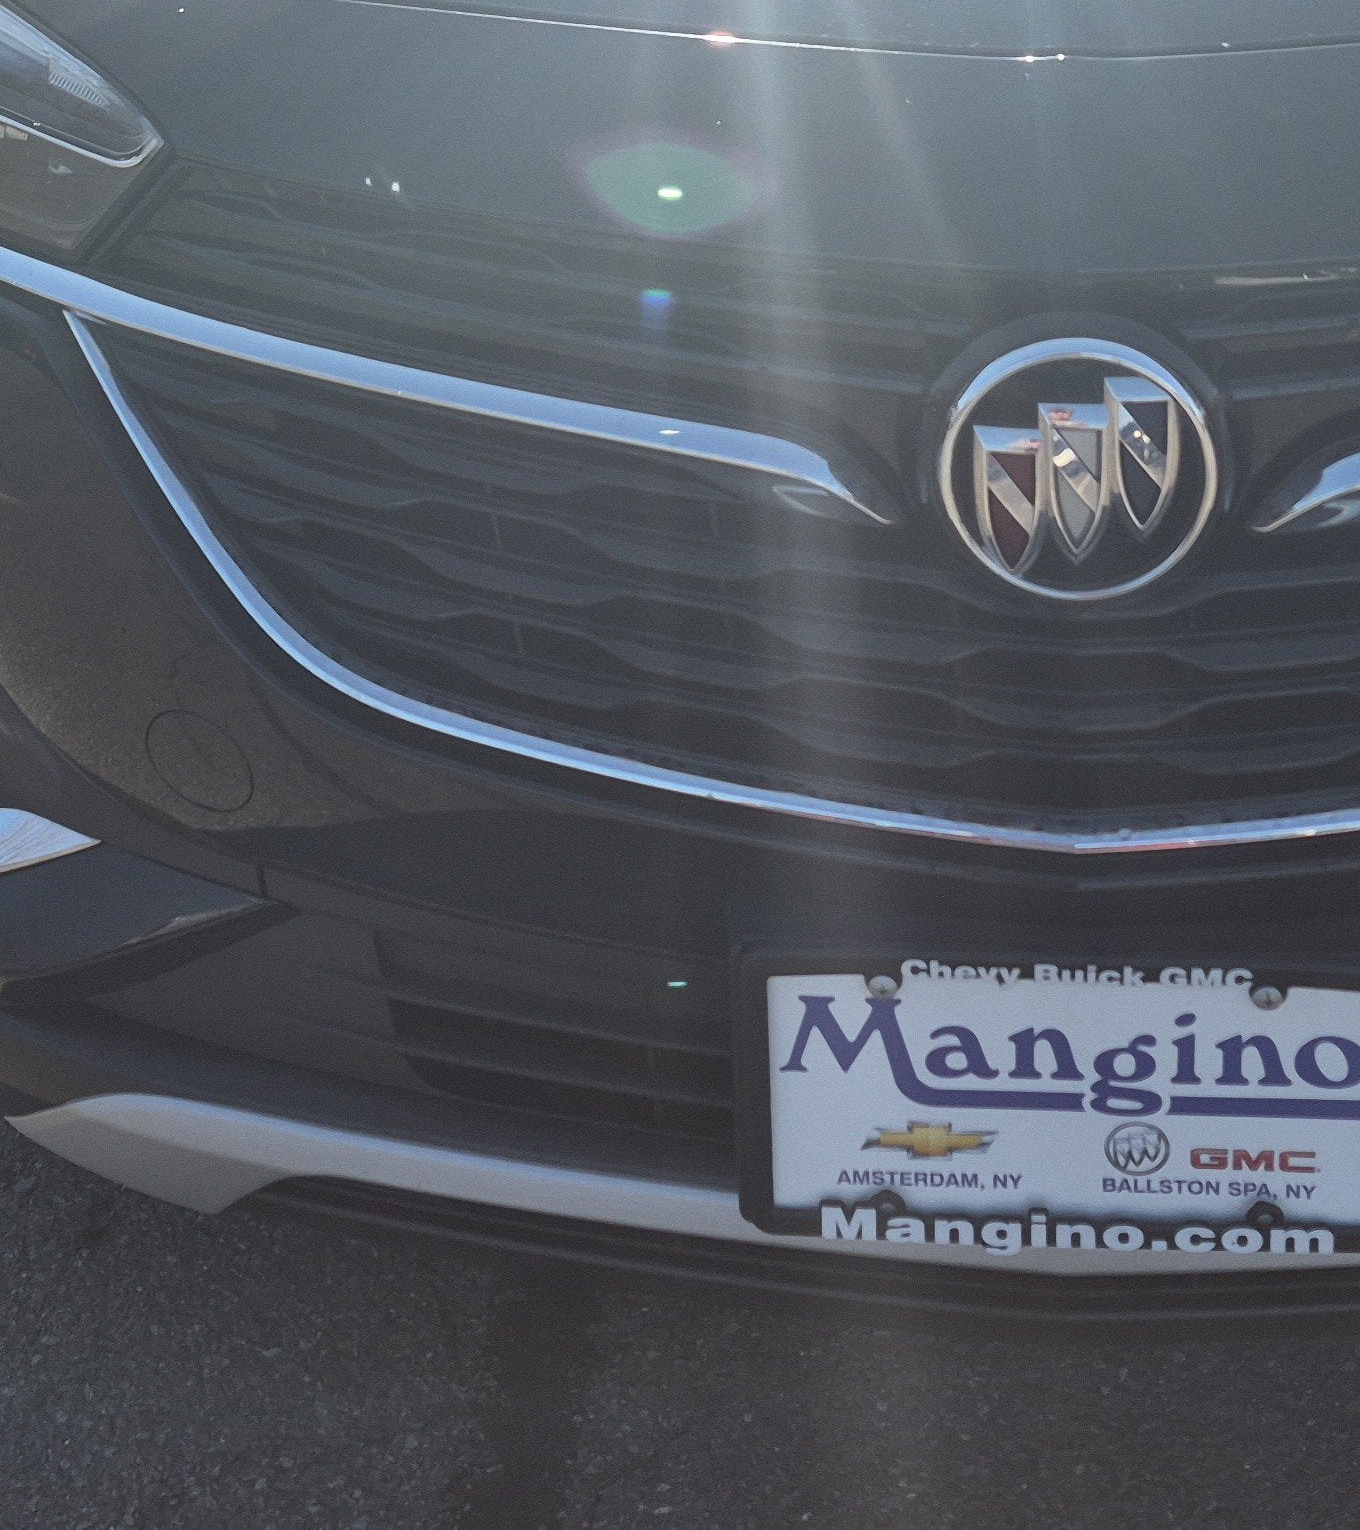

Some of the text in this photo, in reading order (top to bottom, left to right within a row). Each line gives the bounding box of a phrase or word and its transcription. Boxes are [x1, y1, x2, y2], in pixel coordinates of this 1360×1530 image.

[900, 958, 1254, 990] Chevy Buick GMC
[1189, 1147, 1321, 1174] GMC
[836, 1169, 1023, 1192] AMSTERDAM, NY
[1102, 1177, 1317, 1201] BALLSTON SPA, NY
[820, 1205, 1335, 1257] Mangino.com
